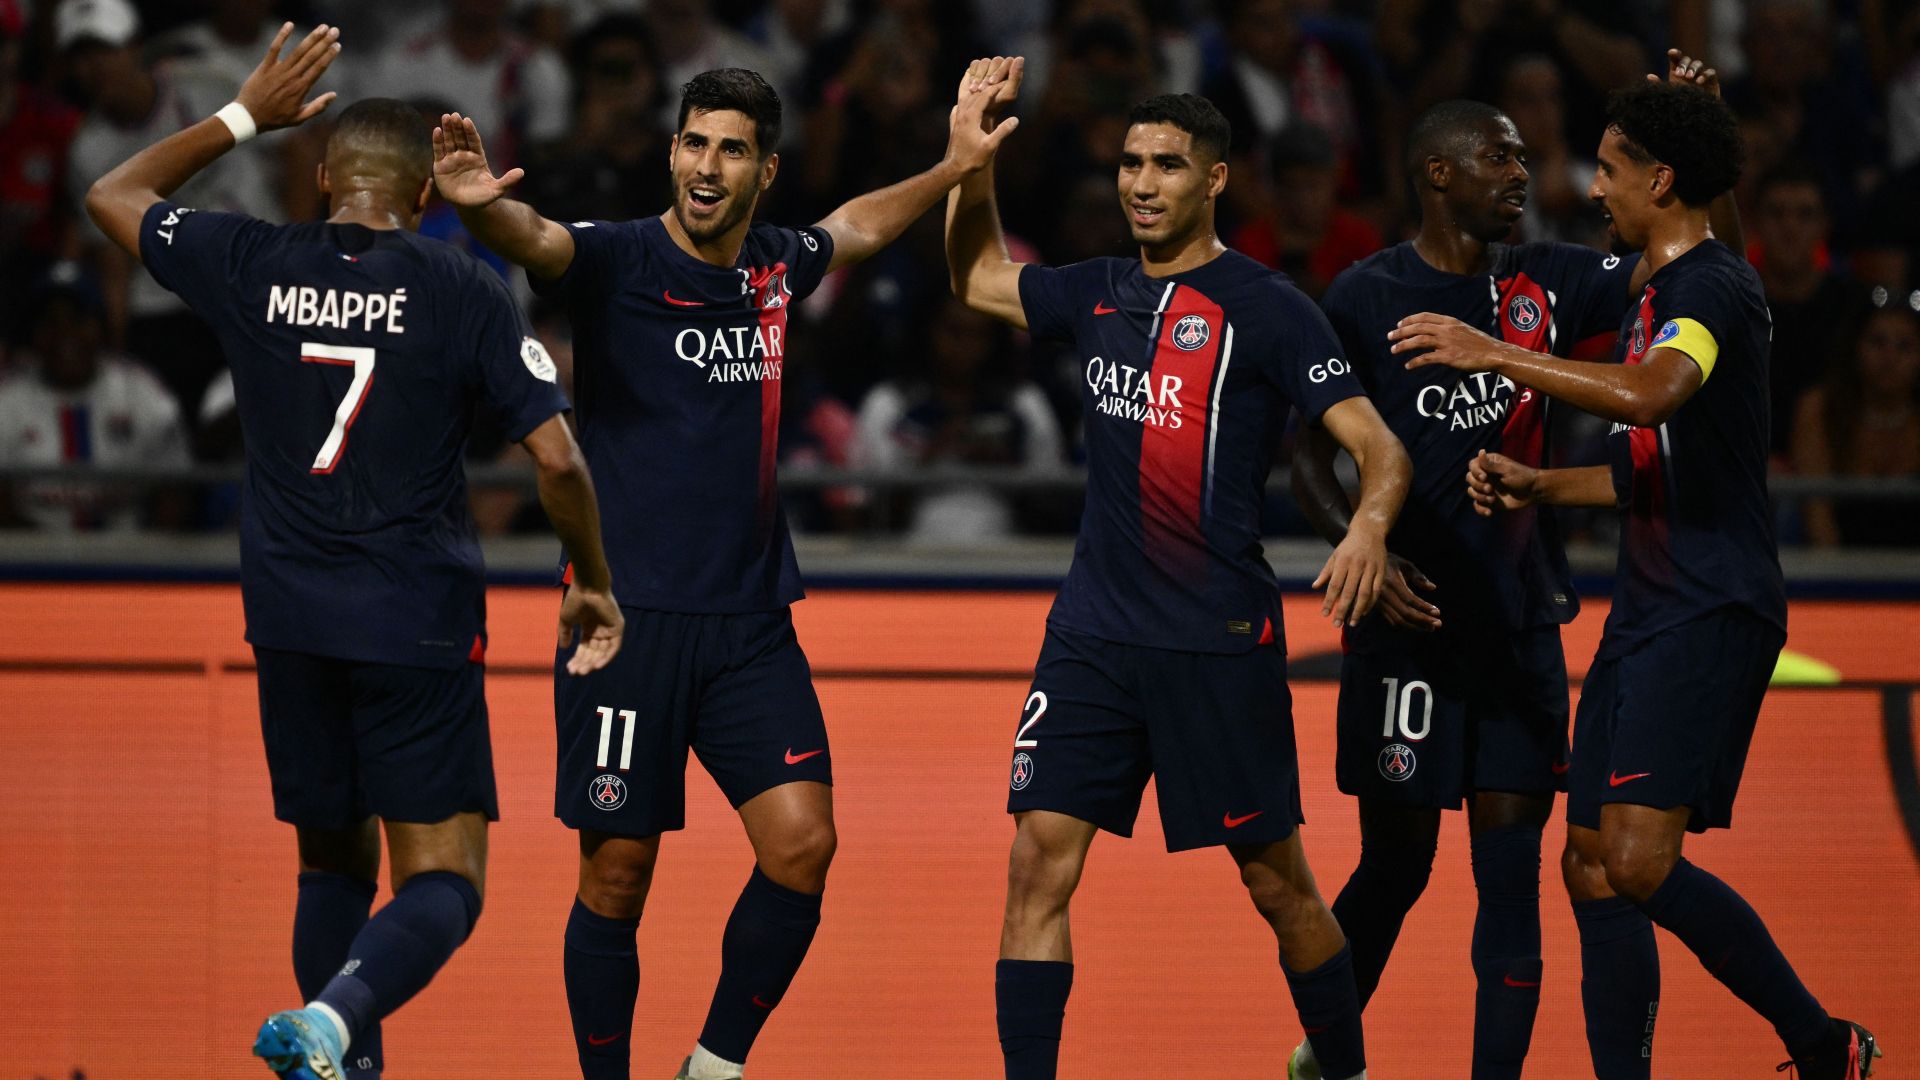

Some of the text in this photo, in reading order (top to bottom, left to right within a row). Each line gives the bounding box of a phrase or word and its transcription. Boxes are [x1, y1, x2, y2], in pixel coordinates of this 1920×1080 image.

[266, 284, 408, 334] MBAPPÉ
[674, 325, 783, 369] QATAR
[708, 360, 782, 383] AIRWAYS
[1086, 356, 1183, 408] QATAR
[1416, 371, 1518, 420] QATA
[299, 341, 376, 475] 7
[1095, 394, 1183, 429] AIRWAYS
[1014, 690, 1048, 751] 2
[1381, 677, 1433, 743] 10
[595, 705, 637, 773] 11
[1385, 746, 1410, 756] PARIS
[595, 776, 620, 787] PARIS
[1641, 1000, 1659, 1058] PARIS
